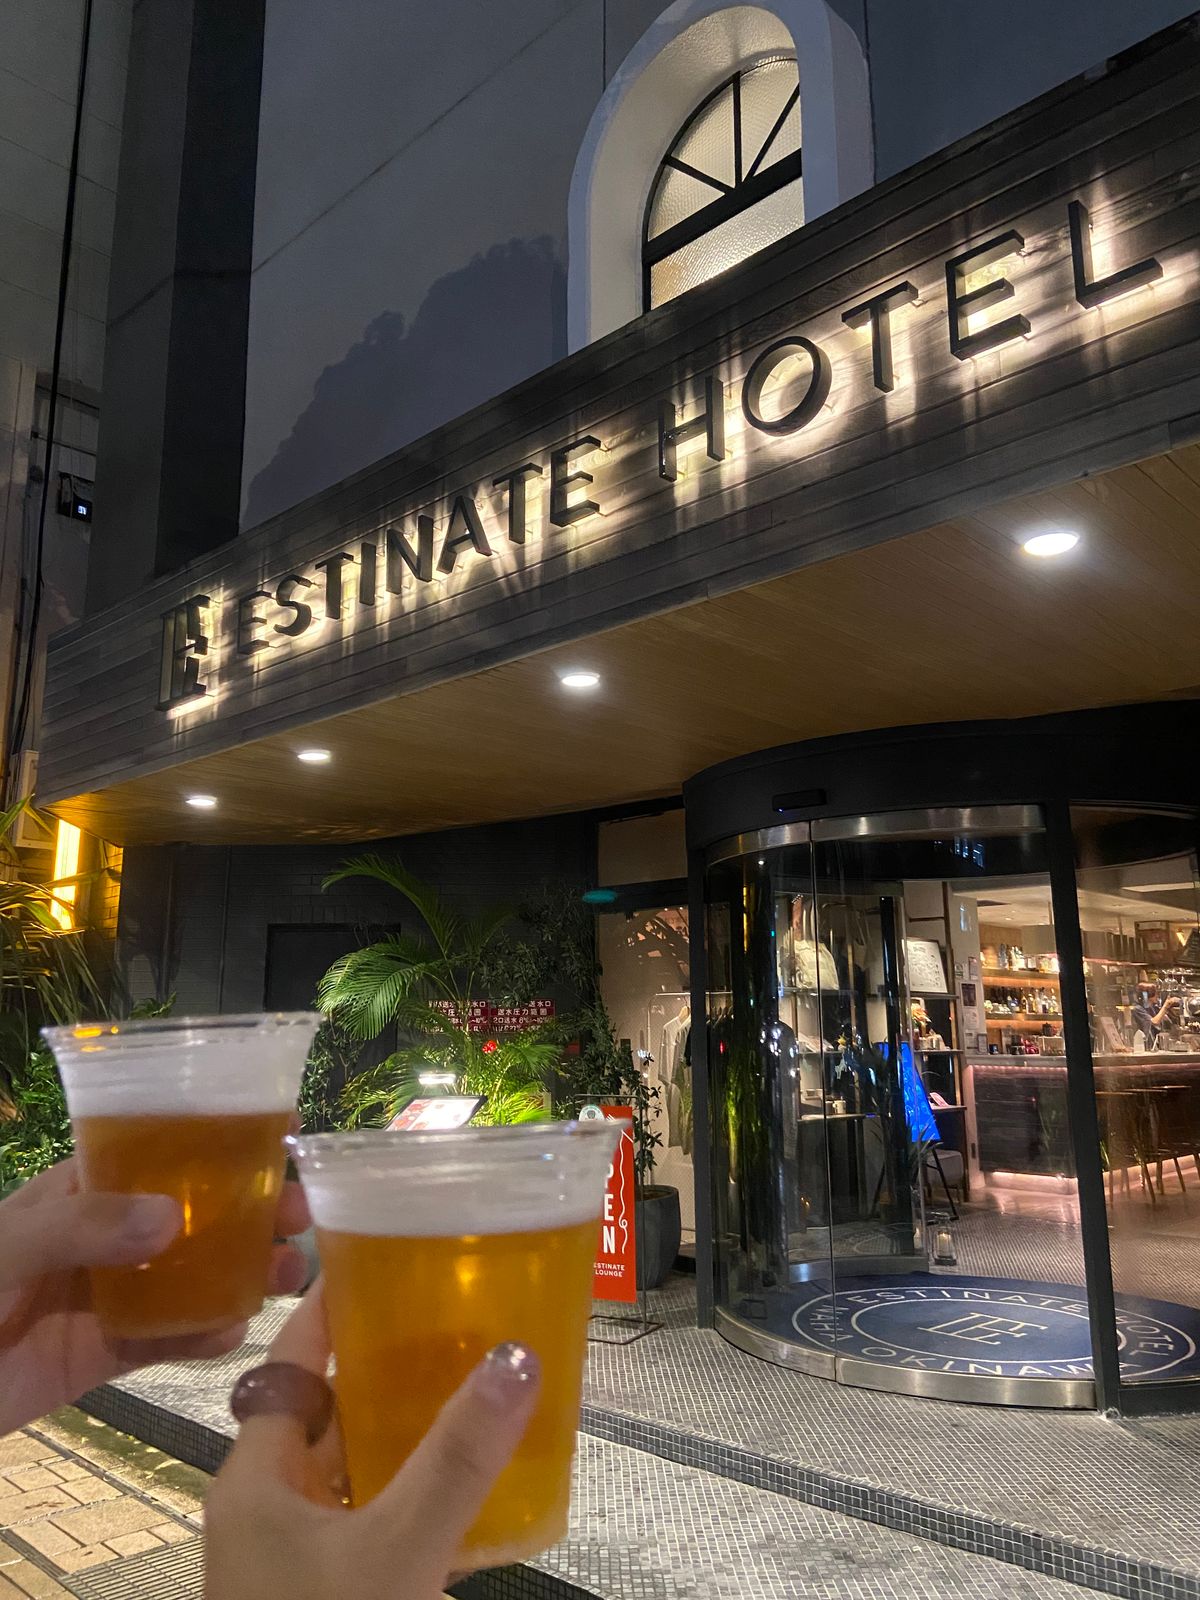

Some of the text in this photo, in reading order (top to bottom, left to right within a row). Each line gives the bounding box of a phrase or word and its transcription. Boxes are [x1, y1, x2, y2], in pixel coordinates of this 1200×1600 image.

[238, 434, 602, 655] ESTINATE
[657, 199, 1164, 483] HOTEL
[595, 1269, 623, 1278] LOUNGE
[846, 1289, 1088, 1313] ESTINATE
[809, 1304, 854, 1342] NAHA
